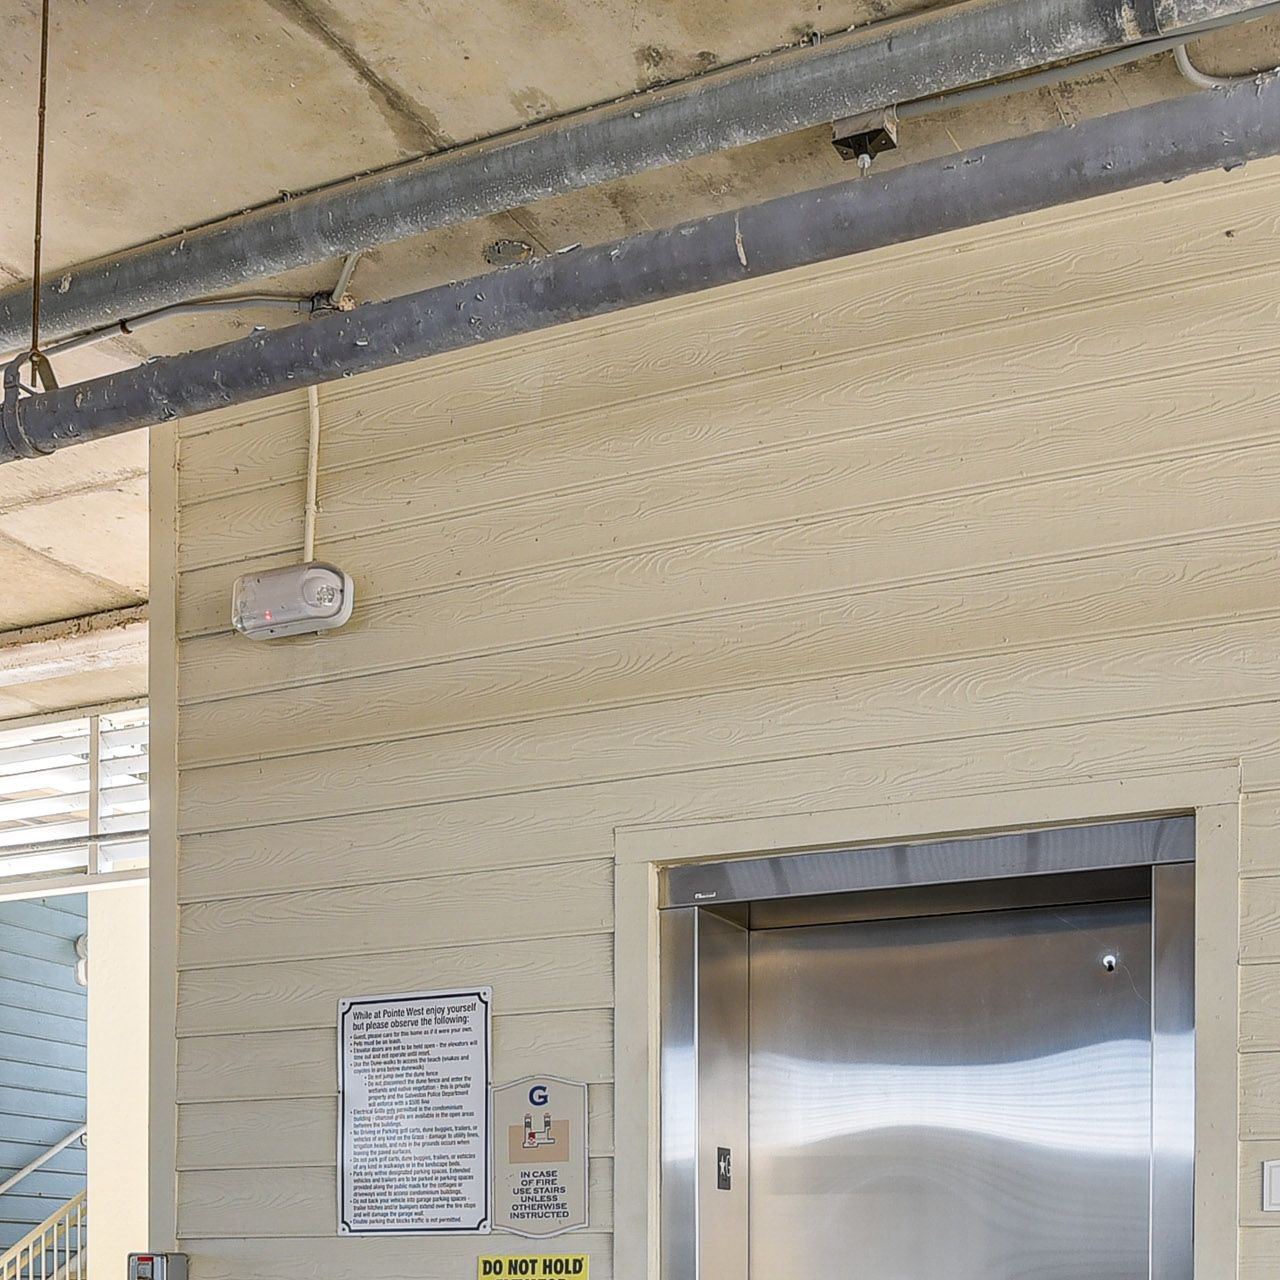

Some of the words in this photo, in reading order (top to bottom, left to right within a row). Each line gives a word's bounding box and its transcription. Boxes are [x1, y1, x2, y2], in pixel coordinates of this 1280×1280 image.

[352, 1010, 372, 1021] While
[373, 1008, 381, 1019] at
[382, 1007, 404, 1019] Pointe
[405, 1006, 424, 1018] West
[425, 1004, 445, 1017] enjoy
[446, 1002, 476, 1015] yourself
[352, 1020, 364, 1030] but
[365, 1018, 388, 1030] please
[390, 1017, 418, 1028] observe
[420, 1016, 432, 1026] the
[434, 1013, 469, 1027] following:
[528, 1085, 548, 1106] G
[510, 1211, 569, 1219] INSTRUCTED
[512, 1203, 567, 1211] OTHERWISE
[483, 1260, 502, 1275] DO
[508, 1259, 537, 1275] NOT
[543, 1258, 583, 1274] HOLD
